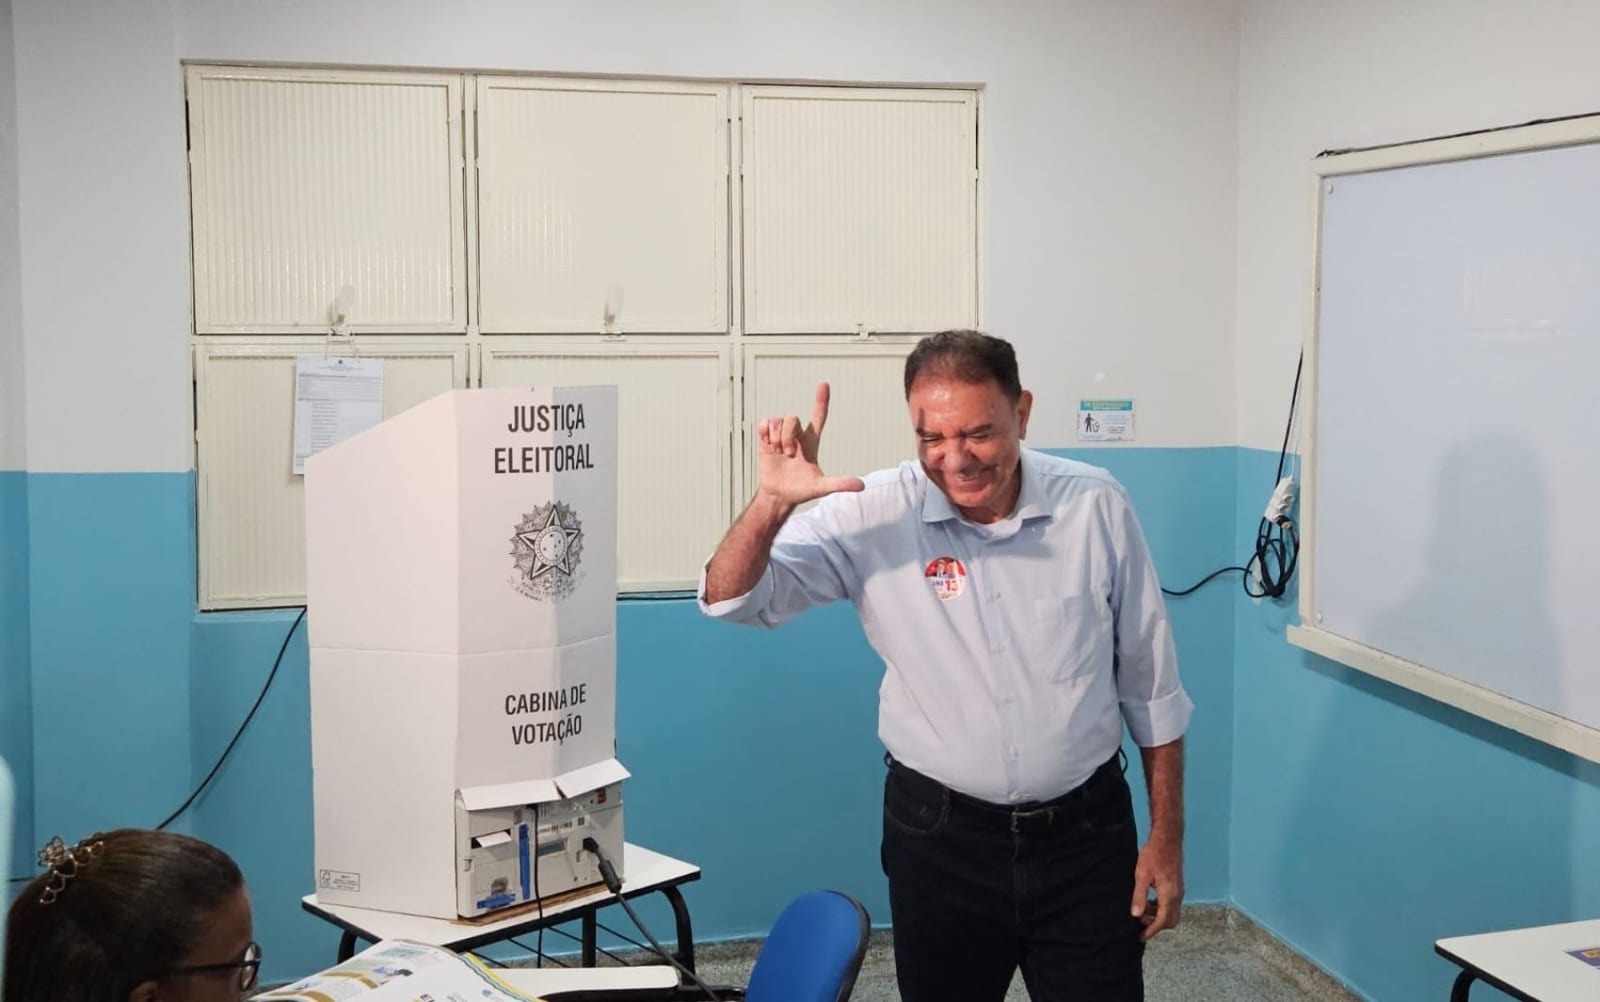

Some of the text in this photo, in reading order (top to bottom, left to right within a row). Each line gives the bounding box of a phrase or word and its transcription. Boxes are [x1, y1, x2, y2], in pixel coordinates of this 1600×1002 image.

[508, 404, 585, 437] JUSTIÇA
[494, 443, 594, 474] ELEITORAL
[945, 580, 958, 592] 13
[505, 683, 587, 715] CABINA DE
[511, 713, 582, 745] VOTAÇÃO
